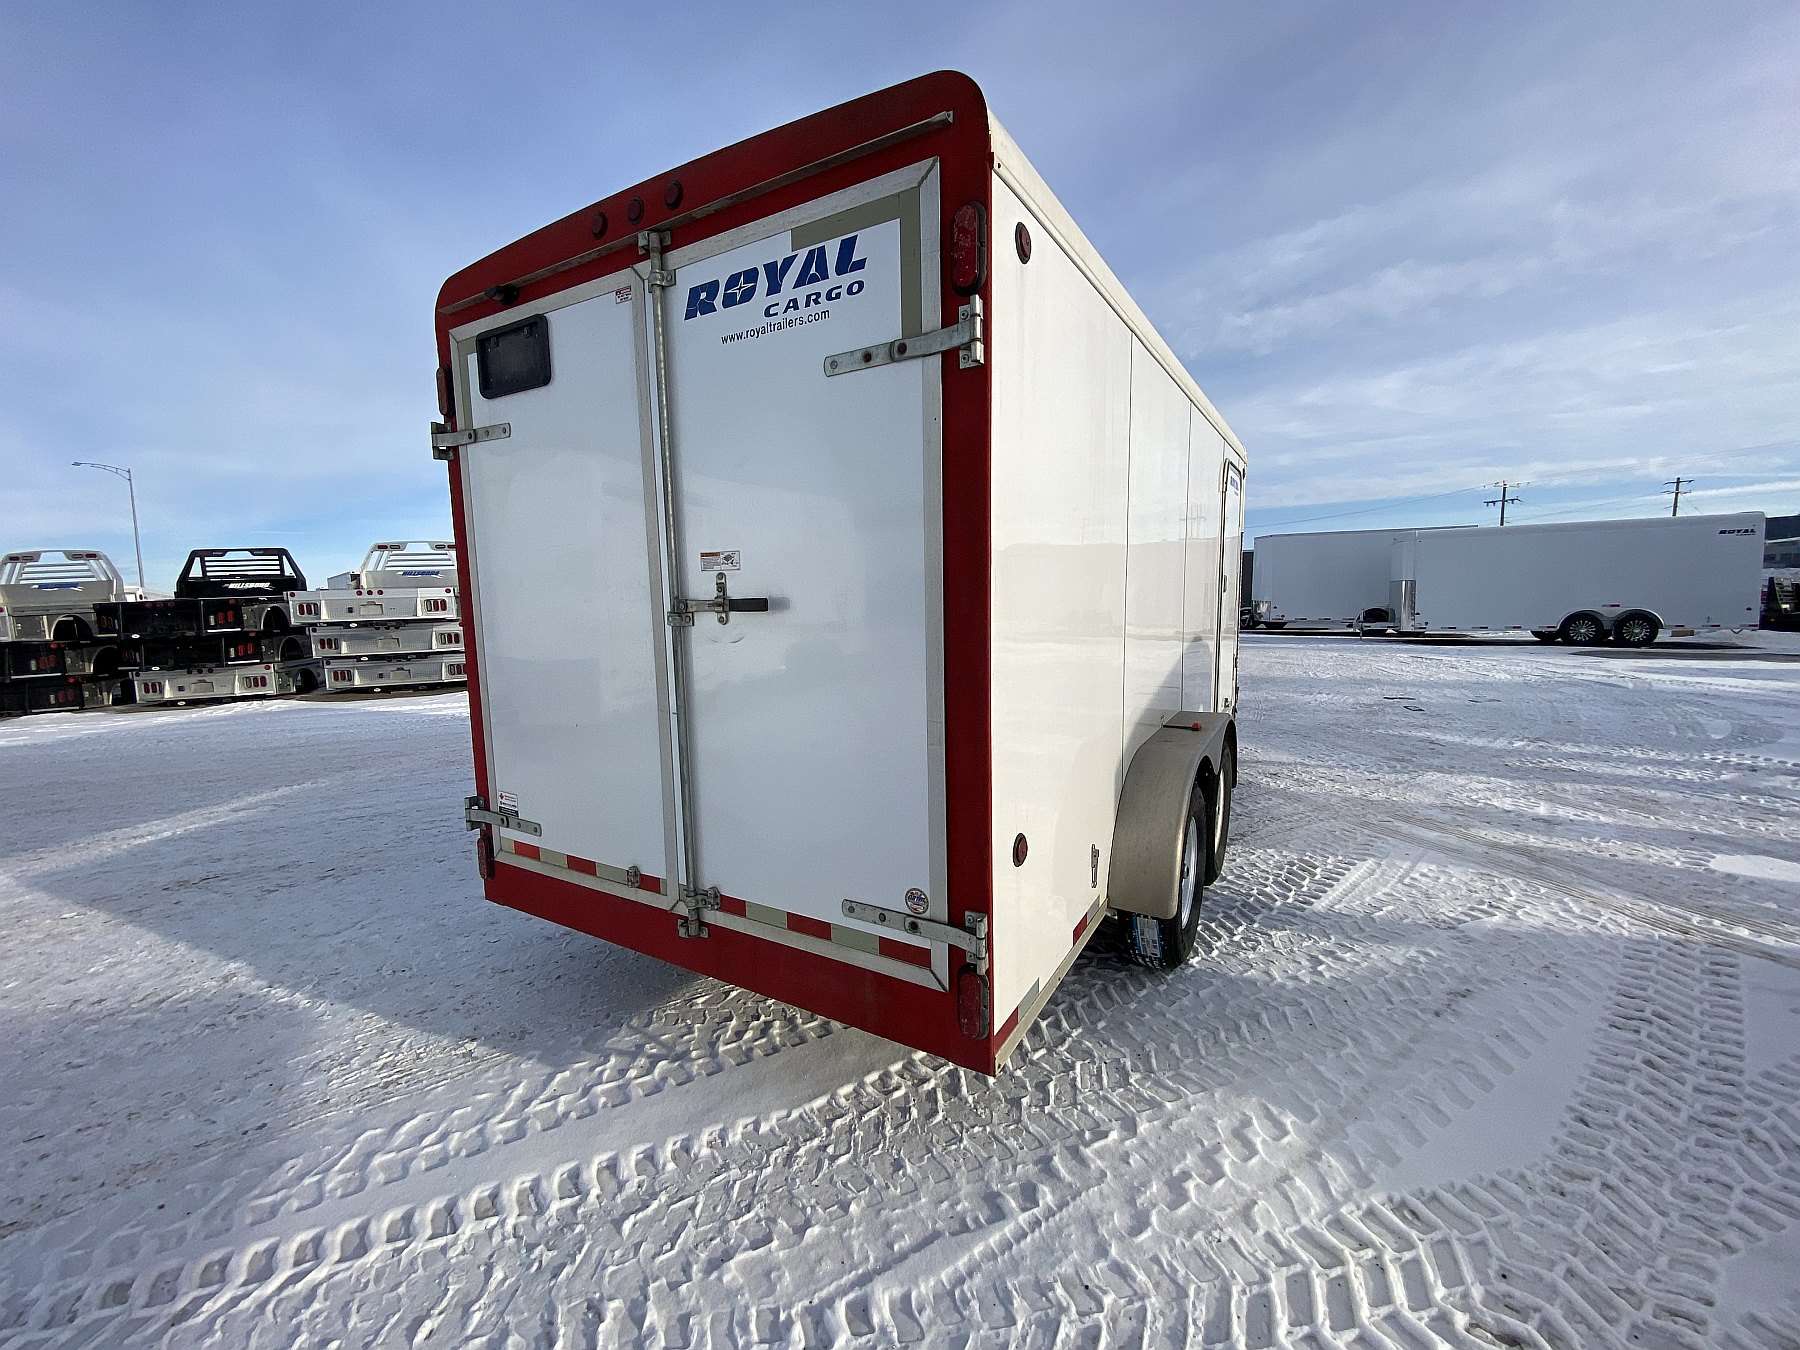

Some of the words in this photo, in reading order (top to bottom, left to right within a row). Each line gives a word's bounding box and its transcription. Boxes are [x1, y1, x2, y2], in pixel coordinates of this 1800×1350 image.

[684, 234, 867, 320] ROYAL
[763, 280, 865, 318] CARGO
[721, 309, 830, 345] www.royaltrailers.com
